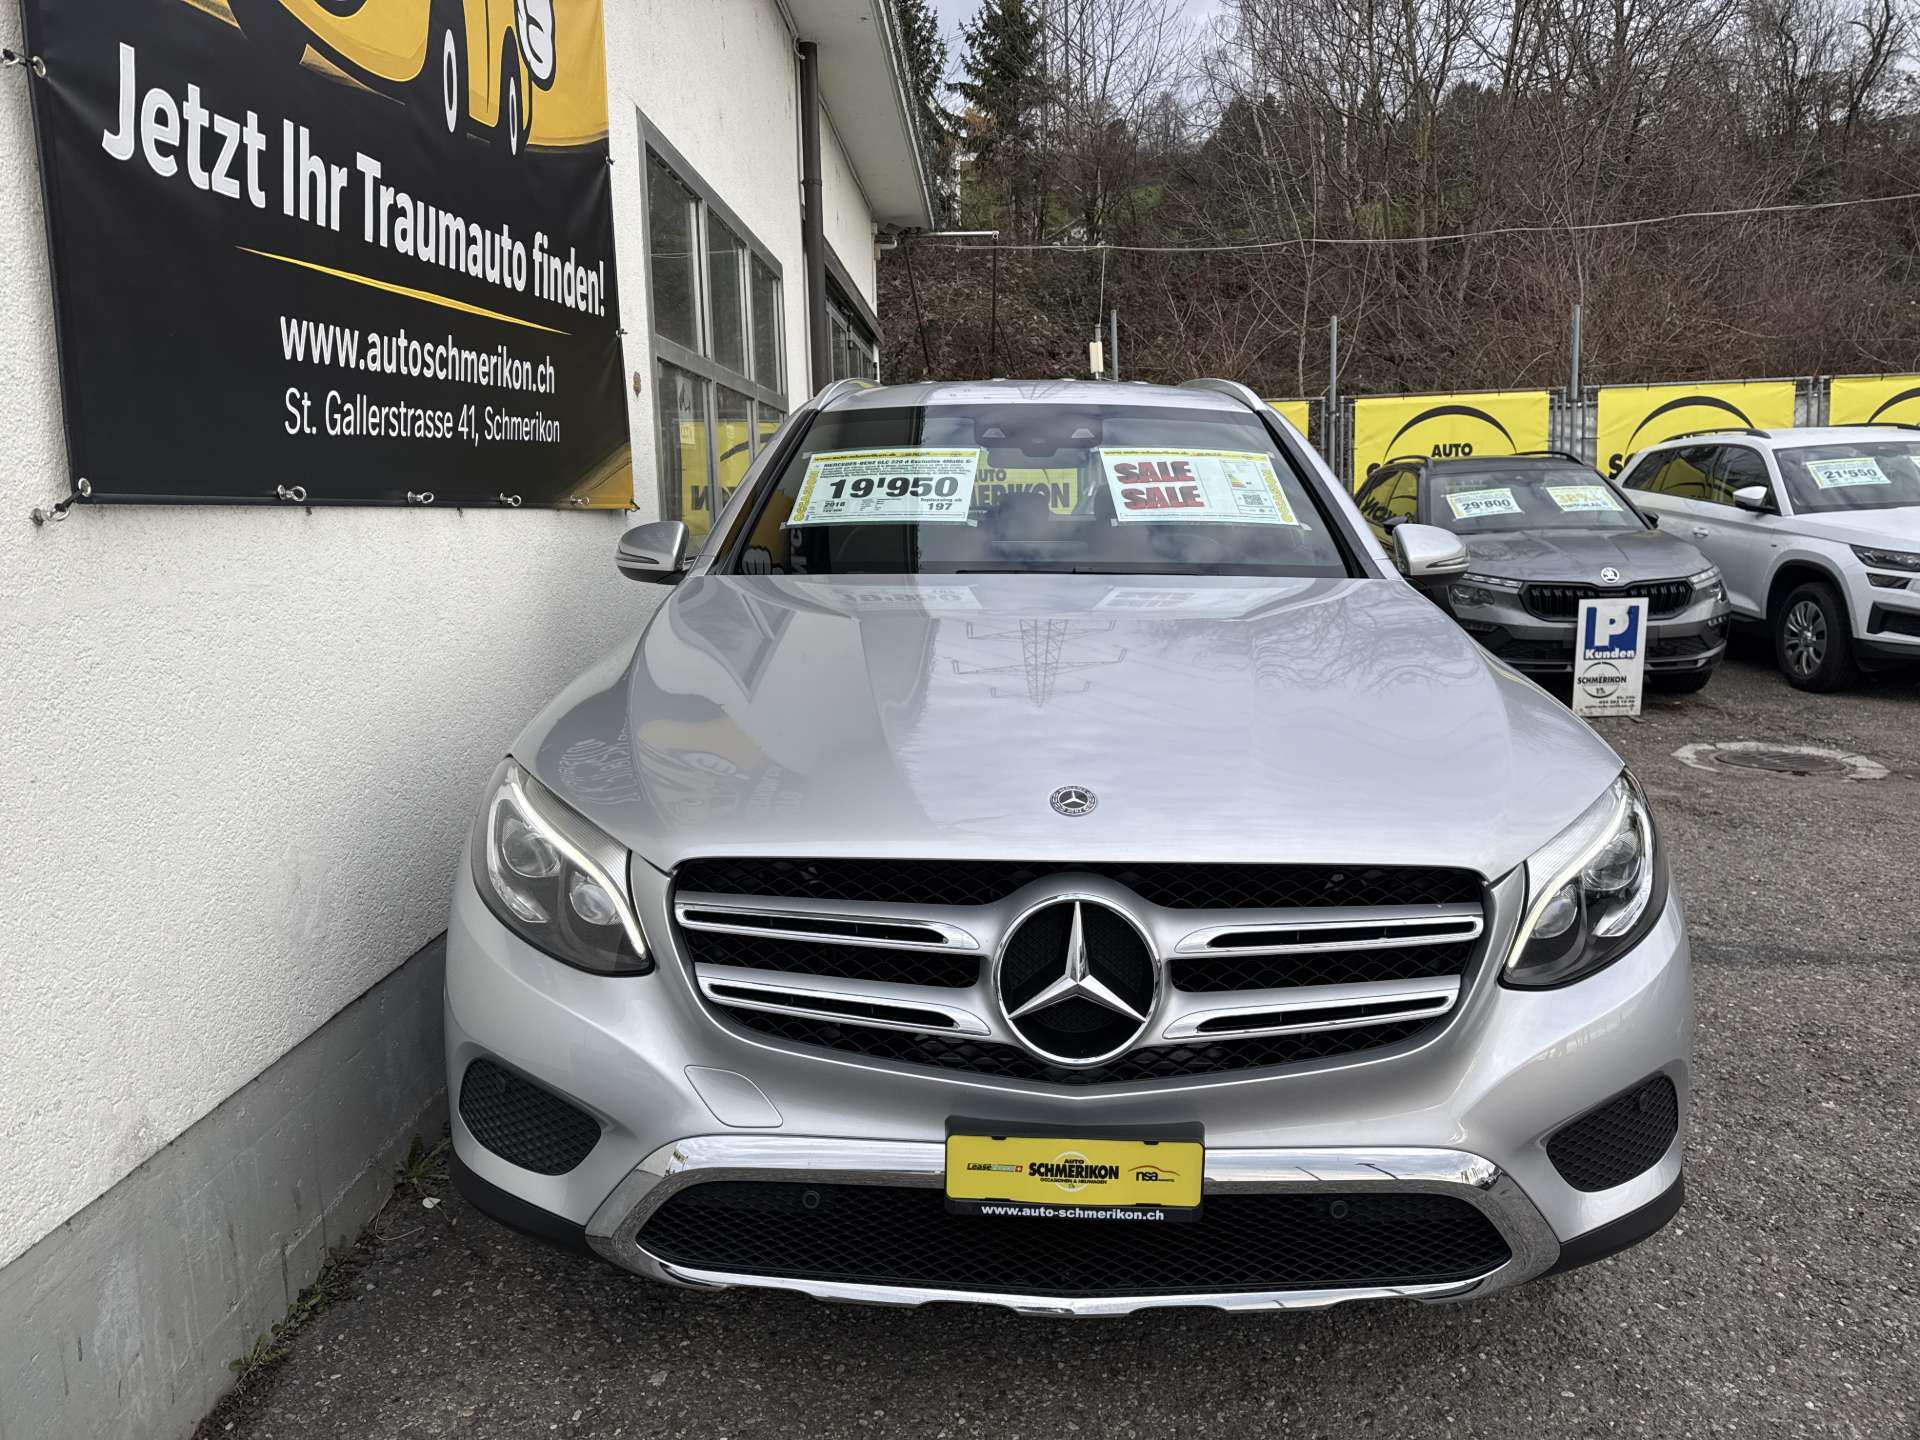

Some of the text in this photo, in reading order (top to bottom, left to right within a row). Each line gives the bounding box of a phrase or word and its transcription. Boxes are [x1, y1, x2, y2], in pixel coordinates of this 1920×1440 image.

[102, 42, 605, 316] Jetzt Ihr Traumauto finden!
[280, 316, 556, 394] www.autoschmerikon.ch
[285, 388, 560, 447] St. Gallerstrasse 41, Schmerikon
[1431, 443, 1473, 458] AUTO
[1113, 461, 1196, 484] SALE
[1823, 468, 1878, 479] 21'550
[830, 476, 959, 499] 19'950
[927, 502, 953, 511] 197
[1120, 486, 1205, 510] SALE
[1461, 498, 1512, 511] 29'800
[1594, 606, 1630, 647] P
[1585, 648, 1635, 659] Kunden
[1577, 675, 1627, 685] SCHMERIKON
[1028, 1162, 1120, 1180] SCHMERIKON
[1135, 1171, 1159, 1182] nsa
[981, 1205, 1165, 1221] www.auto-schmerikon.ch
